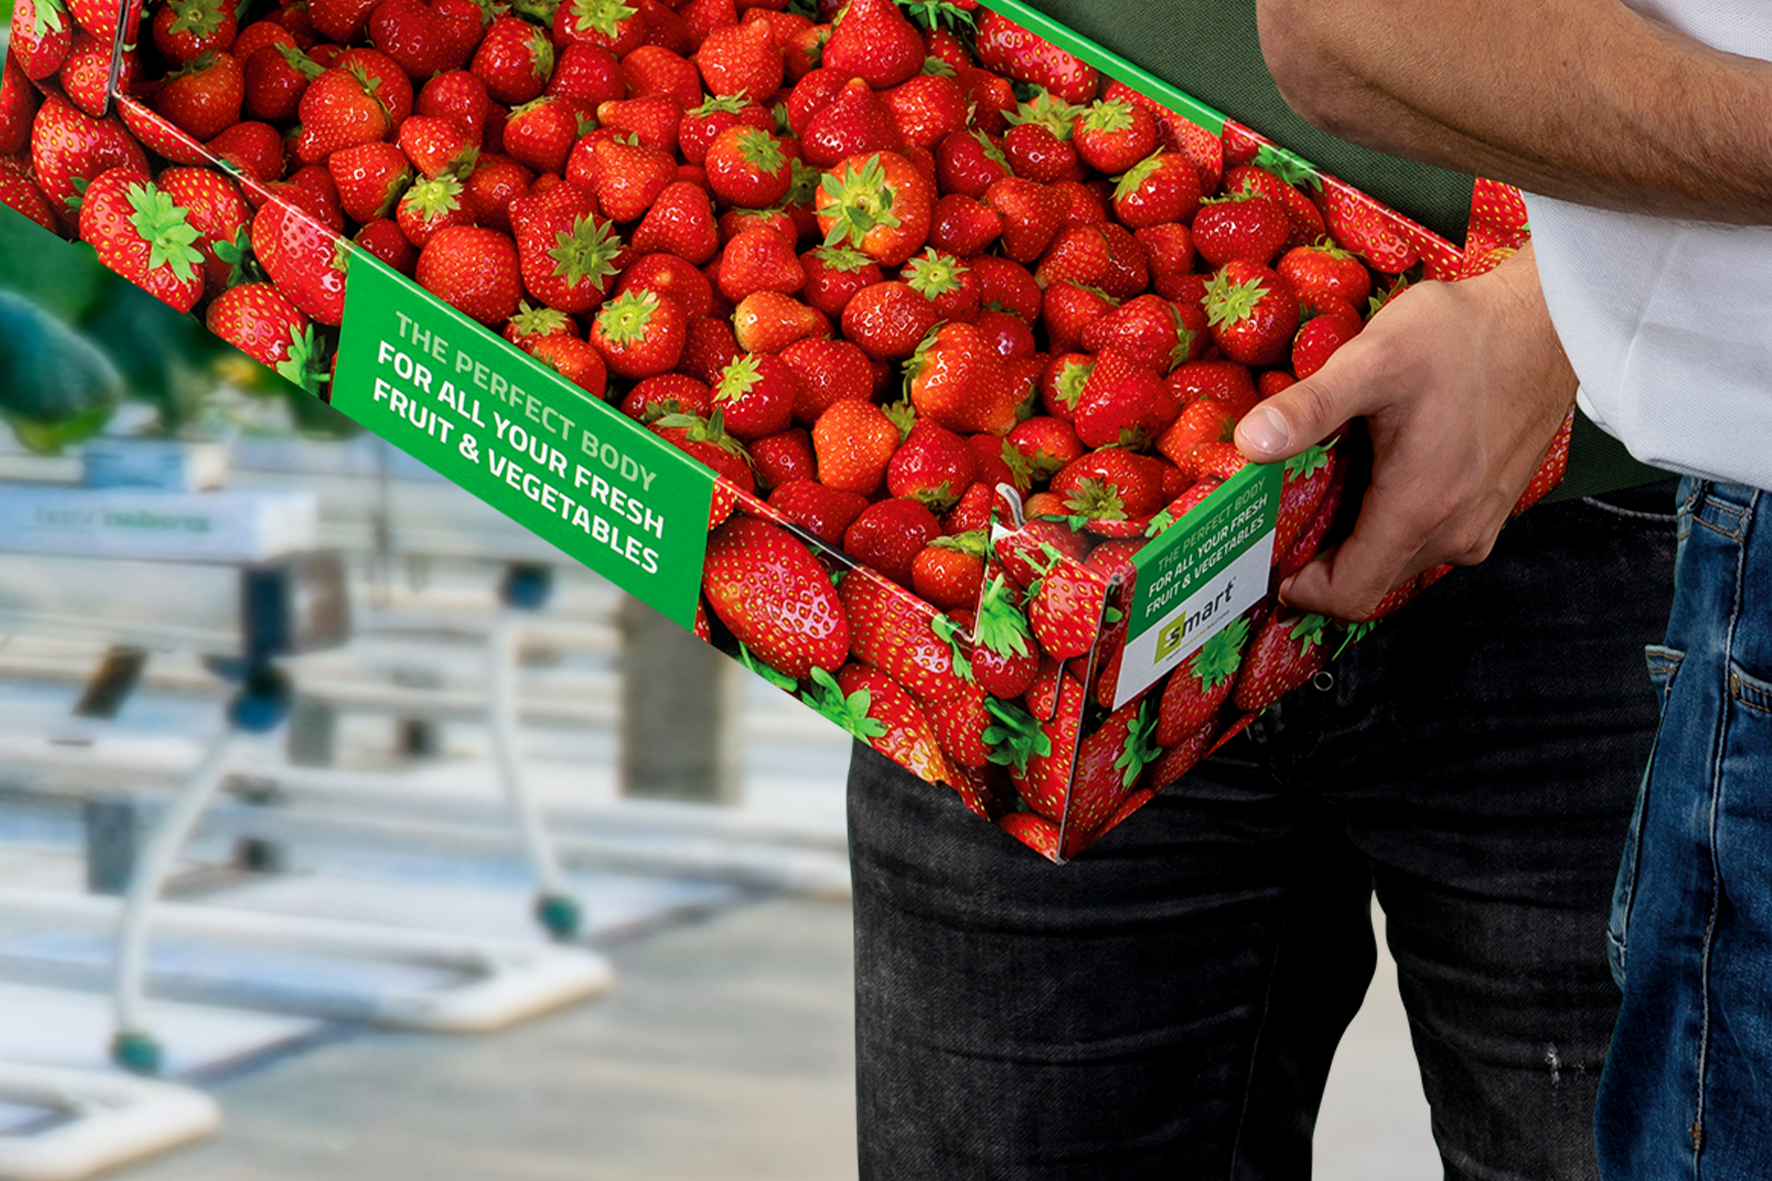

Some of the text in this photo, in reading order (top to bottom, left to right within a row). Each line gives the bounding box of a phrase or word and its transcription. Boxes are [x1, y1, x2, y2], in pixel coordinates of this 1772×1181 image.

[377, 340, 664, 540] FOR ALL YOUR FRESH
[395, 311, 657, 492] THE PERFECT BODY
[372, 377, 659, 574] FRUIT & VEGETABLES
[1148, 493, 1268, 598] FOR ALL YOUR FRESH
[1158, 477, 1266, 571] THE PERFECT BODY
[1146, 513, 1264, 618] FRUIT & VEGETABLES
